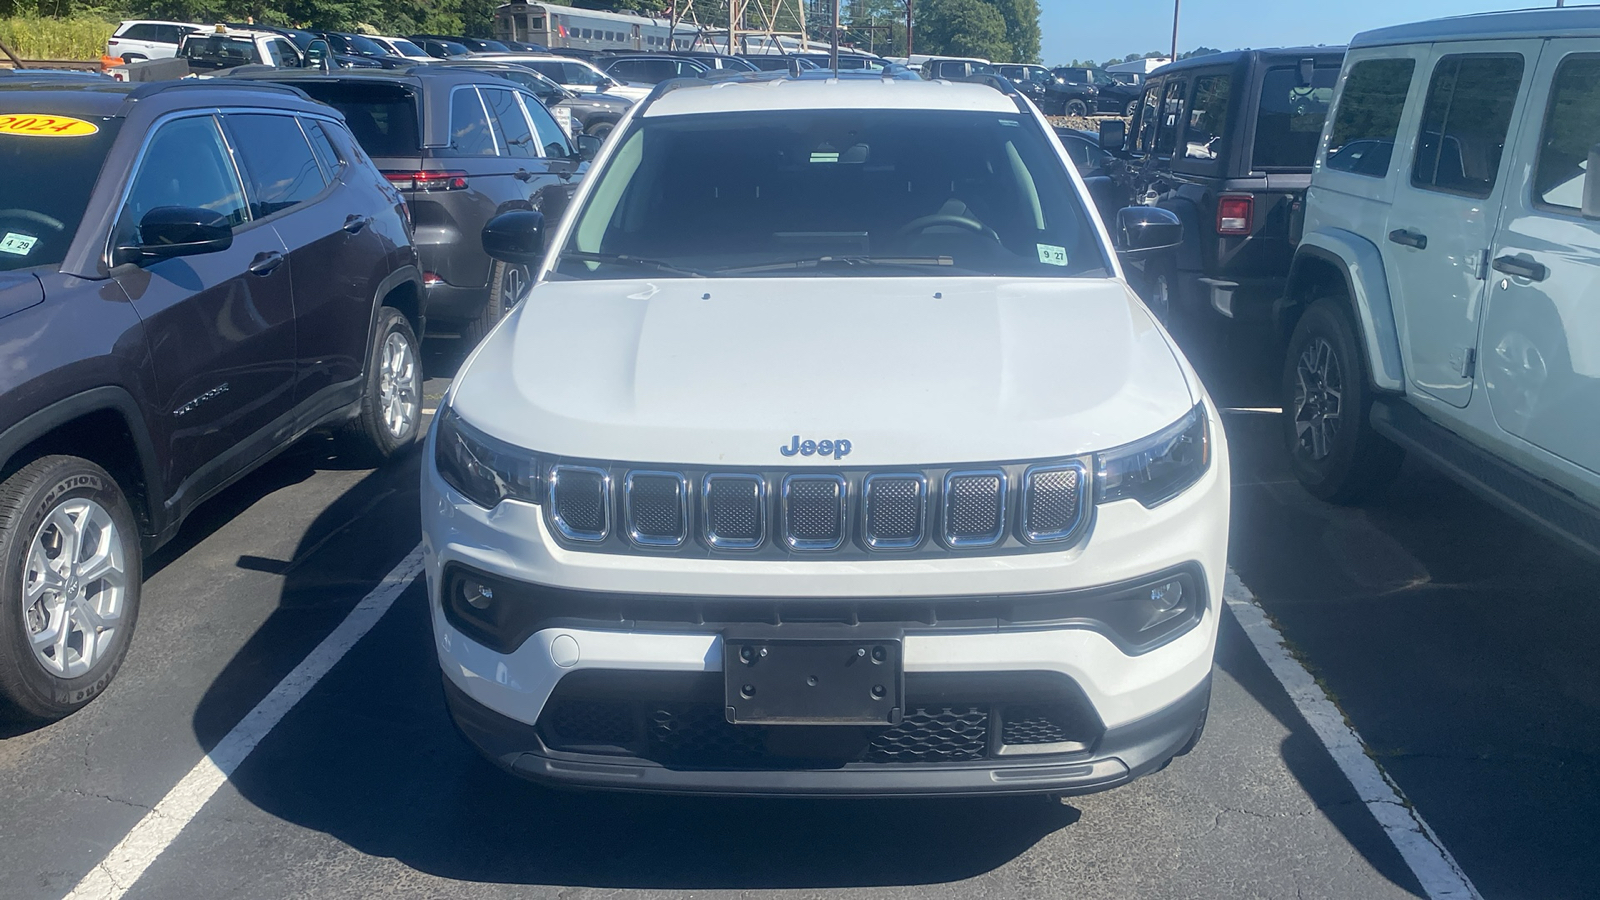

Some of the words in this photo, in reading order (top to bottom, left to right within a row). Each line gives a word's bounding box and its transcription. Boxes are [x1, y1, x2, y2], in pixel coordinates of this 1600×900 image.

[6, 239, 14, 247] 4
[17, 241, 30, 250] 29
[1043, 250, 1050, 259] 9
[1054, 252, 1064, 261] 27
[780, 435, 852, 461] Jeep
